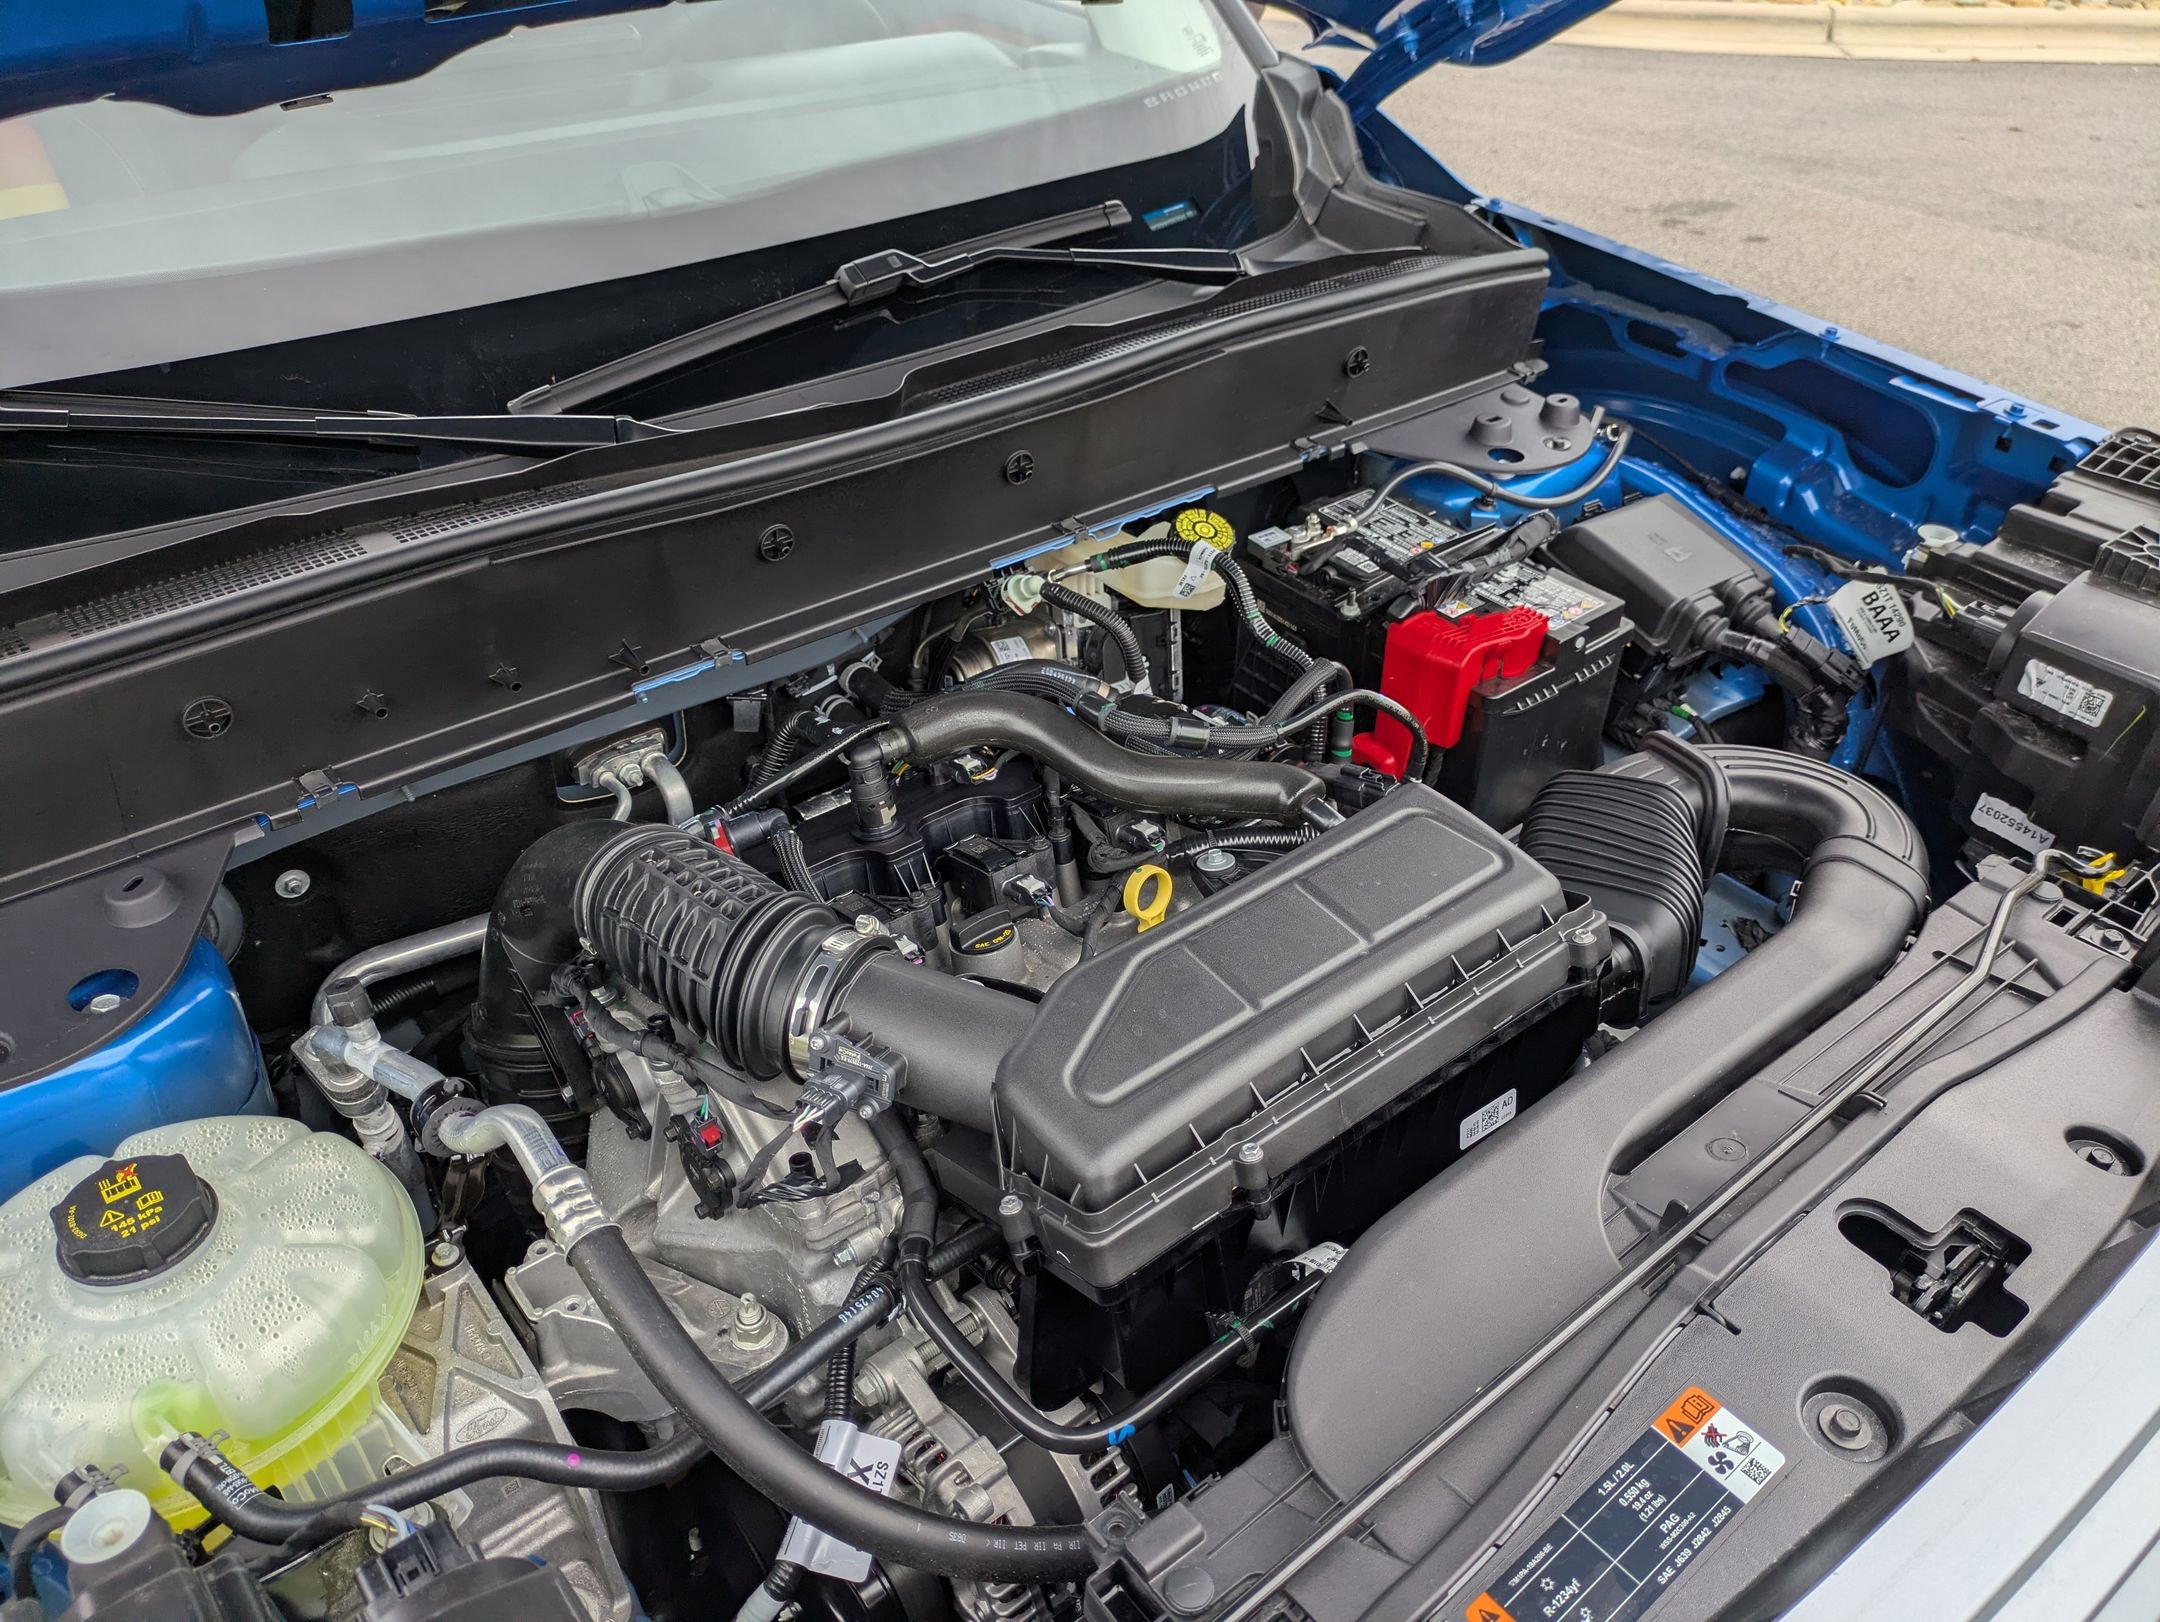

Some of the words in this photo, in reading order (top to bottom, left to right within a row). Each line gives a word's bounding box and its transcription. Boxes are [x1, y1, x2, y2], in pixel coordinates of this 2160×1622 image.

[1862, 591, 1900, 643] BAAA
[1978, 804, 2050, 844] A14552037
[1501, 1096, 1514, 1110] AD
[111, 1216, 136, 1234] 145
[136, 1205, 163, 1222] kPa
[120, 1226, 138, 1239] 21
[140, 1216, 161, 1233] psi
[847, 1457, 873, 1485] X
[1598, 1480, 1616, 1496] 1.5L
[1616, 1462, 1635, 1478] 2.0L
[1619, 1486, 1640, 1506] 0.550
[1635, 1478, 1650, 1490] kg
[1632, 1497, 1646, 1511] 19.4
[1644, 1491, 1654, 1500] oz
[1639, 1505, 1655, 1522] (1.21
[1651, 1494, 1667, 1508] lbs)
[1659, 1513, 1680, 1533] PAG
[1657, 1566, 1676, 1584] SAE
[1674, 1548, 1692, 1567] J639
[1691, 1527, 1712, 1549] J2842
[1712, 1505, 1731, 1527] J2845
[1543, 1578, 1580, 1617] R-1234yf
